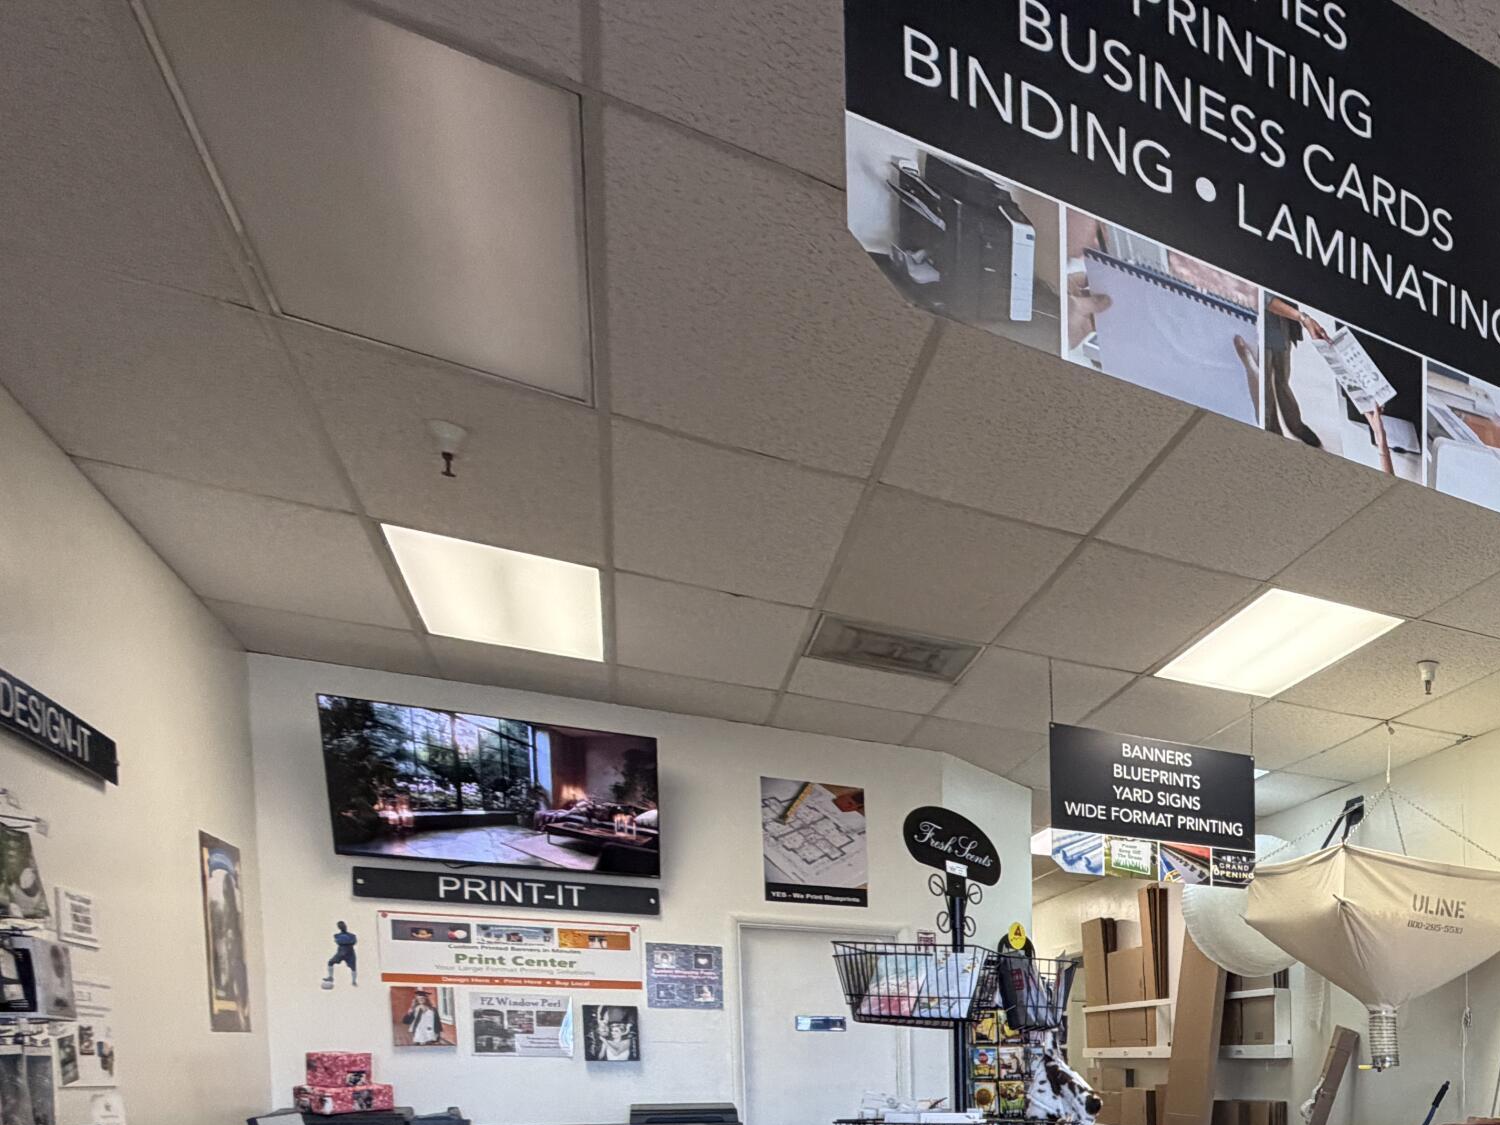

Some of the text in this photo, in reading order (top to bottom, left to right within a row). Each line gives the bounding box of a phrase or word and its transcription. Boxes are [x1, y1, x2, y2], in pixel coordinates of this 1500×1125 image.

[903, 26, 1174, 195] BINDING
[1018, 0, 1455, 253] BUSINESS CARDS
[0, 677, 92, 762] DESIGN-IT
[1121, 742, 1193, 767] BANNERS
[1113, 763, 1201, 790] BLUEPRINTS
[1112, 785, 1201, 811] YARD SIGNS
[1064, 800, 1244, 837] WIDE FORMAT PRINTING
[913, 821, 994, 868] Fresh Scents
[1213, 868, 1255, 879] OPENING
[1219, 862, 1249, 872] GRAND
[437, 875, 586, 908] PRINT-IT
[1412, 893, 1467, 919] ULINE
[453, 952, 577, 970] Print Center
[495, 996, 539, 1007] Window
